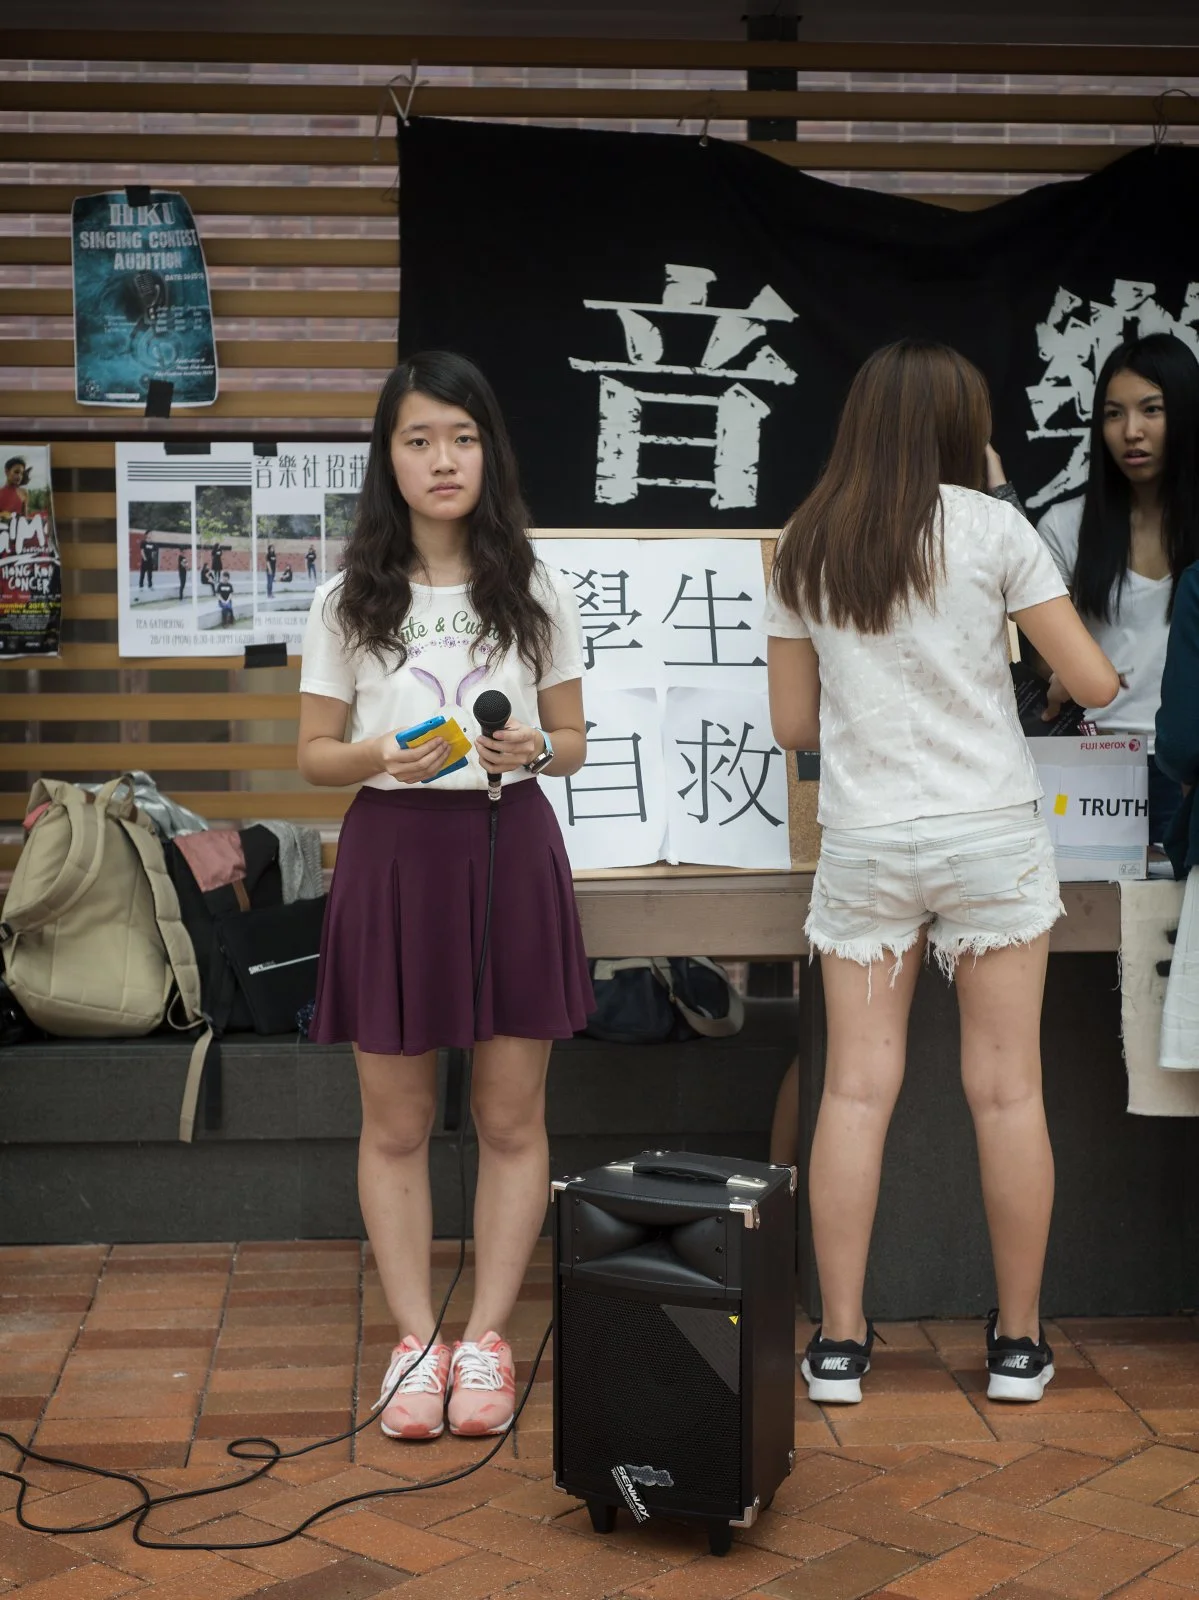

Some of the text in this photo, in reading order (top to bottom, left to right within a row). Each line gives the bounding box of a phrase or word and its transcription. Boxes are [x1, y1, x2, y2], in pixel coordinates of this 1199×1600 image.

[108, 202, 177, 226] HKU
[79, 228, 199, 249] SINGING CONTEST
[113, 251, 183, 270] AUDITION
[568, 263, 800, 510] 音
[2, 564, 32, 579] HONG
[8, 576, 51, 595] CONCER
[434, 616, 445, 633] &
[1080, 740, 1126, 751] FUJI xerox
[564, 718, 786, 828] 自救
[1079, 798, 1149, 817] TRUTH
[820, 1356, 850, 1371] NIKE
[1001, 1354, 1029, 1369] NIKE
[616, 1465, 651, 1518] SENWAY
